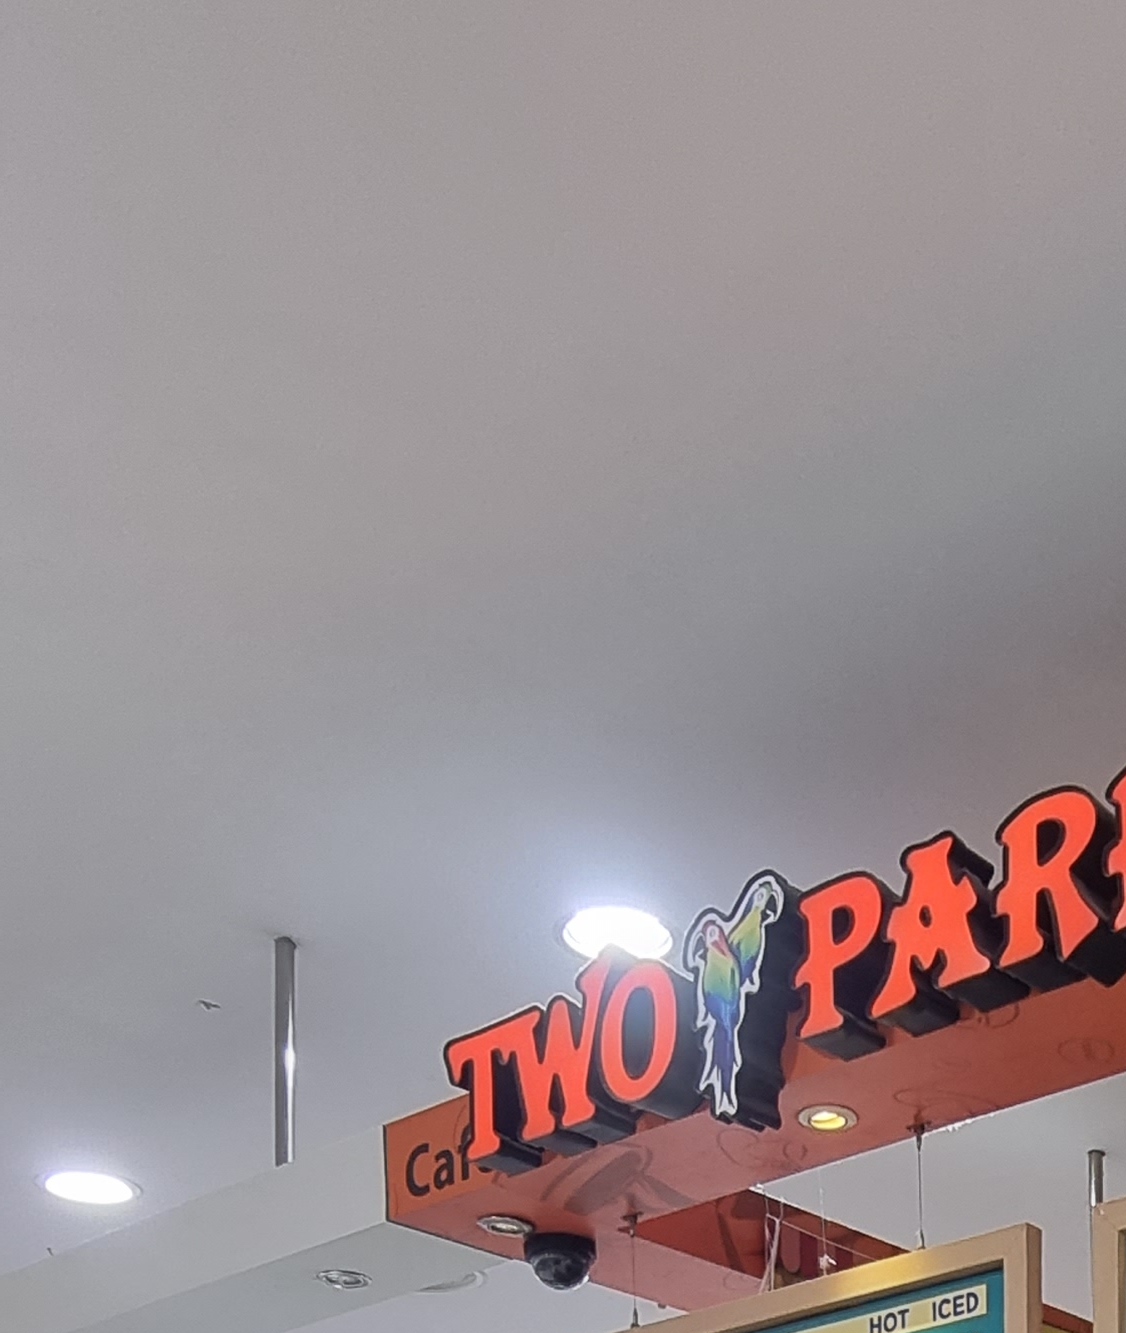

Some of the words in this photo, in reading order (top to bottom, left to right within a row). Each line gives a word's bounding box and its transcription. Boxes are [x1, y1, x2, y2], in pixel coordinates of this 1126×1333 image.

[442, 942, 690, 1165] TWO
[404, 1125, 492, 1197] Caf
[932, 1292, 979, 1322] ICED
